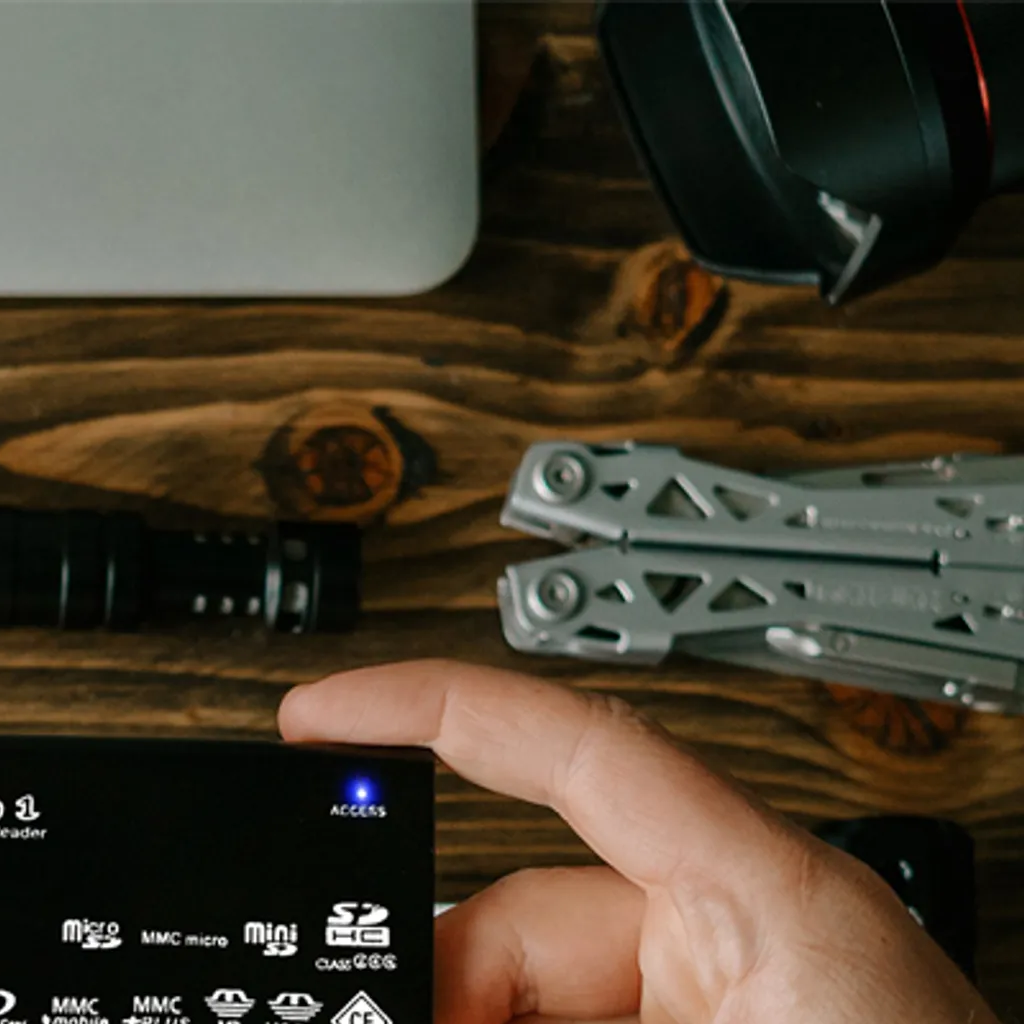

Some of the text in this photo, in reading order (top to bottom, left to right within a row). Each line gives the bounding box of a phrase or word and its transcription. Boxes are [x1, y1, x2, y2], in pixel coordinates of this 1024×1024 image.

[14, 793, 41, 822] 1
[329, 803, 388, 819] ACCESS
[140, 929, 229, 948] MMC micro
[51, 996, 100, 1016] MMC
[132, 995, 183, 1016] MMC
